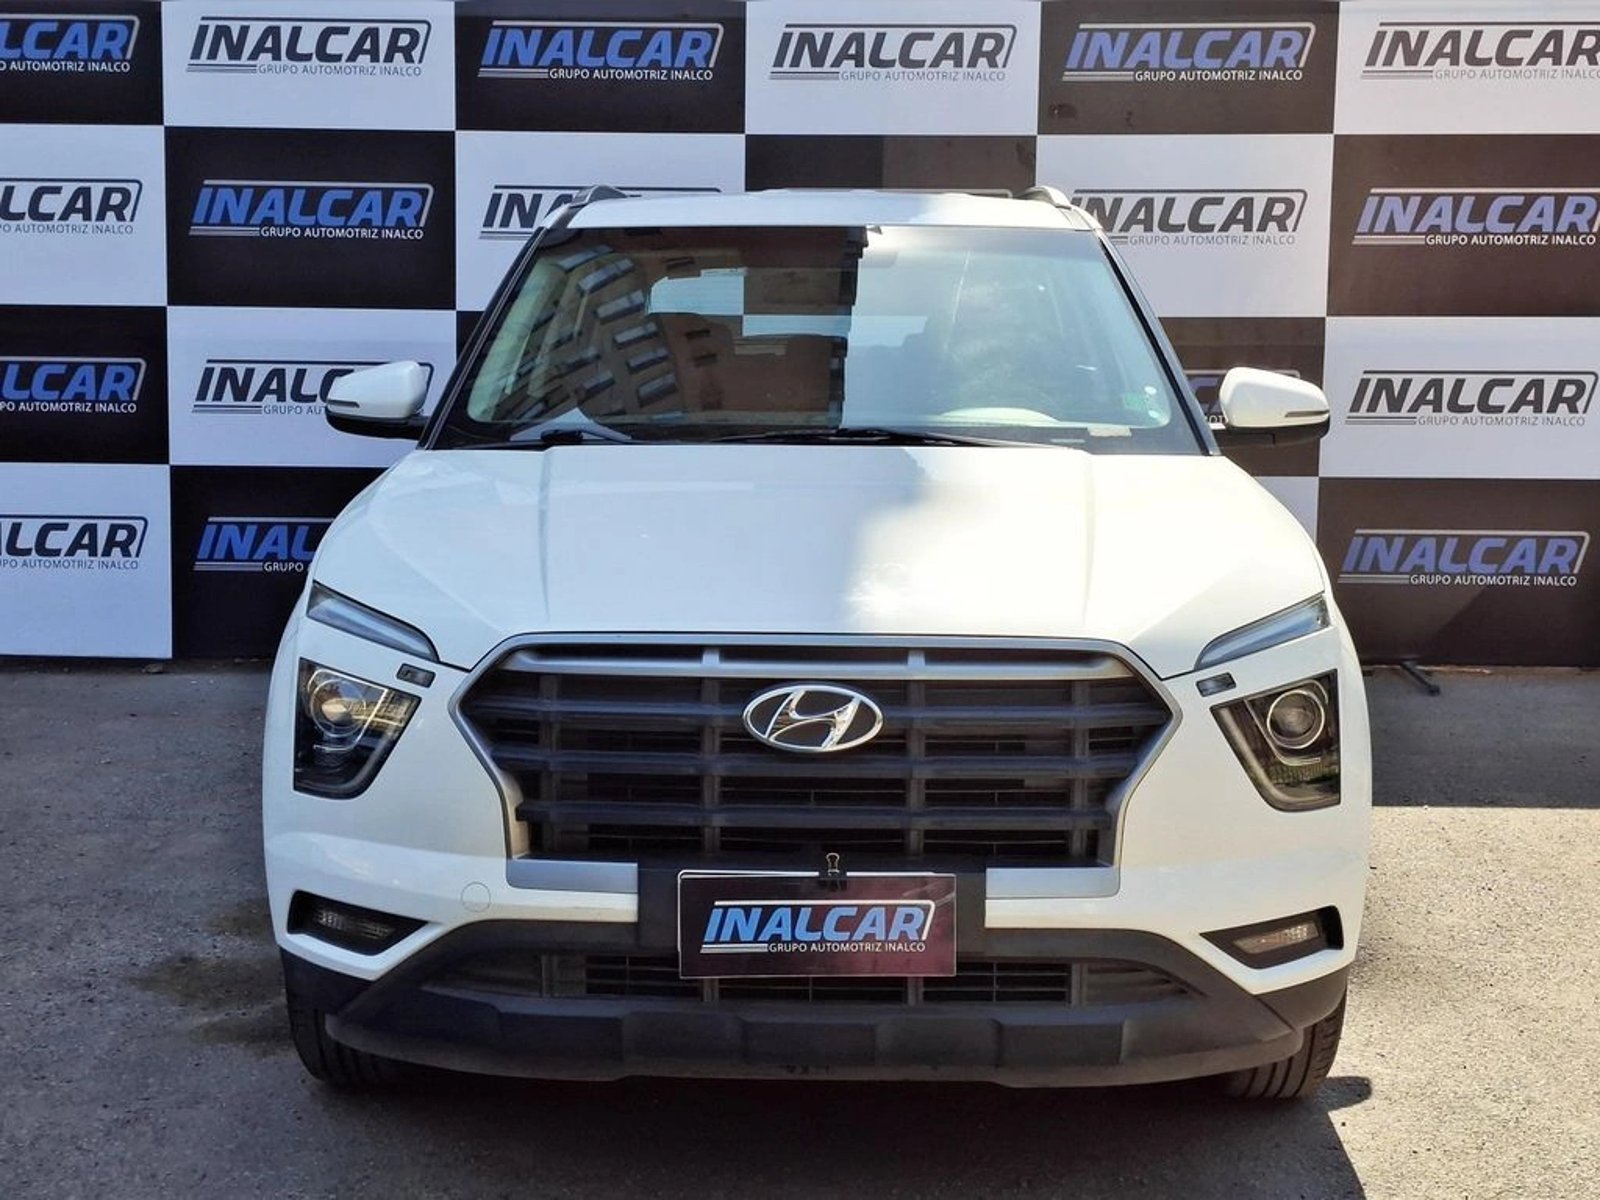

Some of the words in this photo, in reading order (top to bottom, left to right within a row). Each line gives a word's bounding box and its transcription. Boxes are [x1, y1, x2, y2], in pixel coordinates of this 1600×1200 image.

[190, 25, 421, 63] INALCAR
[482, 29, 713, 68] INALCAR
[773, 31, 1005, 69] INALCAR
[1065, 30, 1303, 69] INALCAR
[1365, 29, 1600, 67] INALCAR
[10, 62, 85, 72] AUTOMOTRIZ
[88, 63, 130, 72] INALCO
[258, 64, 299, 75] GRUPO
[302, 65, 377, 76] AUTOMOTRIZ
[380, 66, 422, 77] INALCO
[549, 68, 589, 79] GRUPO
[593, 69, 668, 80] AUTOMOTRIZ
[670, 70, 713, 81] INALCO
[841, 71, 880, 82] GRUPO
[884, 71, 959, 82] AUTOMOTRIZ
[962, 71, 1006, 82] INALCO
[1135, 70, 1175, 82] GRUPO
[1179, 70, 1256, 82] AUTOMOTRIZ
[1259, 70, 1302, 81] INALCO
[1435, 69, 1477, 80] GRUPO
[1480, 69, 1558, 80] AUTOMOTRIZ
[192, 188, 423, 227] INALCAR
[1353, 196, 1598, 234] INALCAR
[15, 224, 88, 235] AUTOMOTRIZ
[92, 224, 133, 235] INALCO
[261, 227, 301, 238] GRUPO
[304, 228, 379, 239] AUTOMOTRIZ
[382, 229, 423, 239] INALCO
[1130, 234, 1169, 245] GRUPO
[1173, 234, 1249, 245] AUTOMOTRIZ
[1252, 234, 1295, 245] INALCO
[1426, 234, 1468, 246] GRUPO
[1471, 234, 1549, 246] AUTOMOTRIZ
[1552, 234, 1596, 246] INALCO
[195, 367, 354, 403] INALC
[1349, 378, 1587, 414] INALCAR
[18, 402, 92, 413] AUTOMOTRIZ
[95, 403, 136, 413] INALCO
[263, 405, 303, 415] GRUPO
[1418, 416, 1459, 426] GRUPO
[1463, 416, 1538, 426] AUTOMOTRIZ
[1542, 416, 1585, 426] INALCO
[0, 523, 137, 558] LCAR
[198, 524, 319, 561] INAL
[1342, 537, 1579, 575] INALCAR
[22, 560, 95, 569] AUTOMOTRIZ
[97, 560, 138, 570] INALCO
[263, 561, 304, 573] GRUPO
[1410, 575, 1451, 586] GRUPO
[1455, 575, 1530, 586] AUTOMOTRIZ
[1534, 576, 1577, 586] INALCO
[704, 907, 924, 942] INALCAR
[770, 943, 807, 952] GRUPO
[811, 942, 882, 952] AUTOMOTRIZ
[885, 942, 925, 952] INALCO
